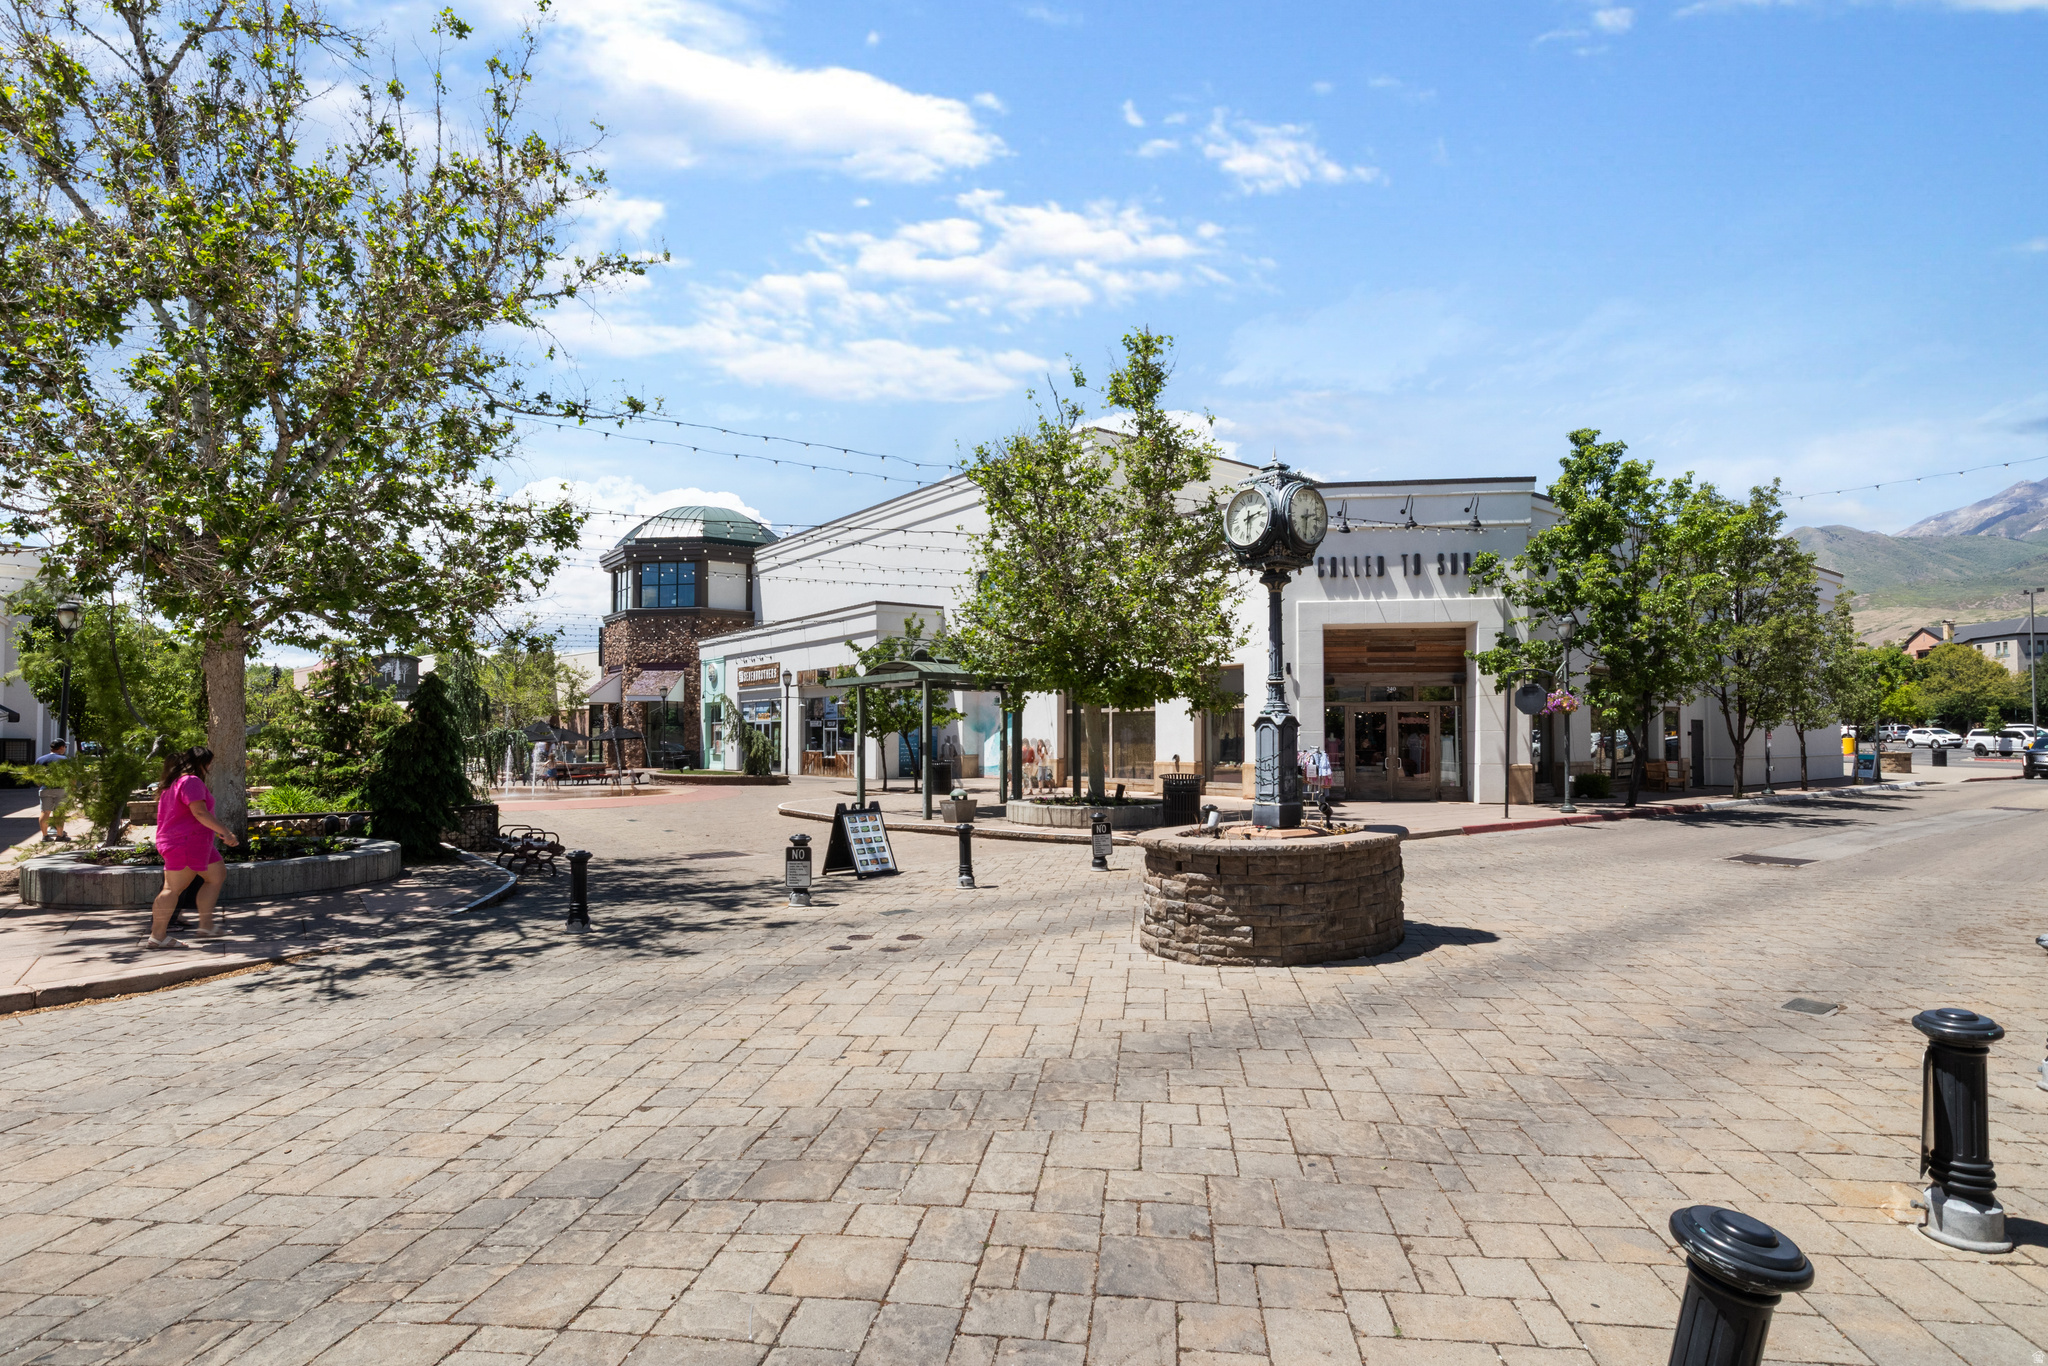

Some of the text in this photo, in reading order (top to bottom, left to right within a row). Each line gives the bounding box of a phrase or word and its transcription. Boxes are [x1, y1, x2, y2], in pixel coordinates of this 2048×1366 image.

[1317, 551, 1480, 578] CALLED TO SUR
[1096, 824, 1107, 834] NO
[791, 849, 805, 860] NO
